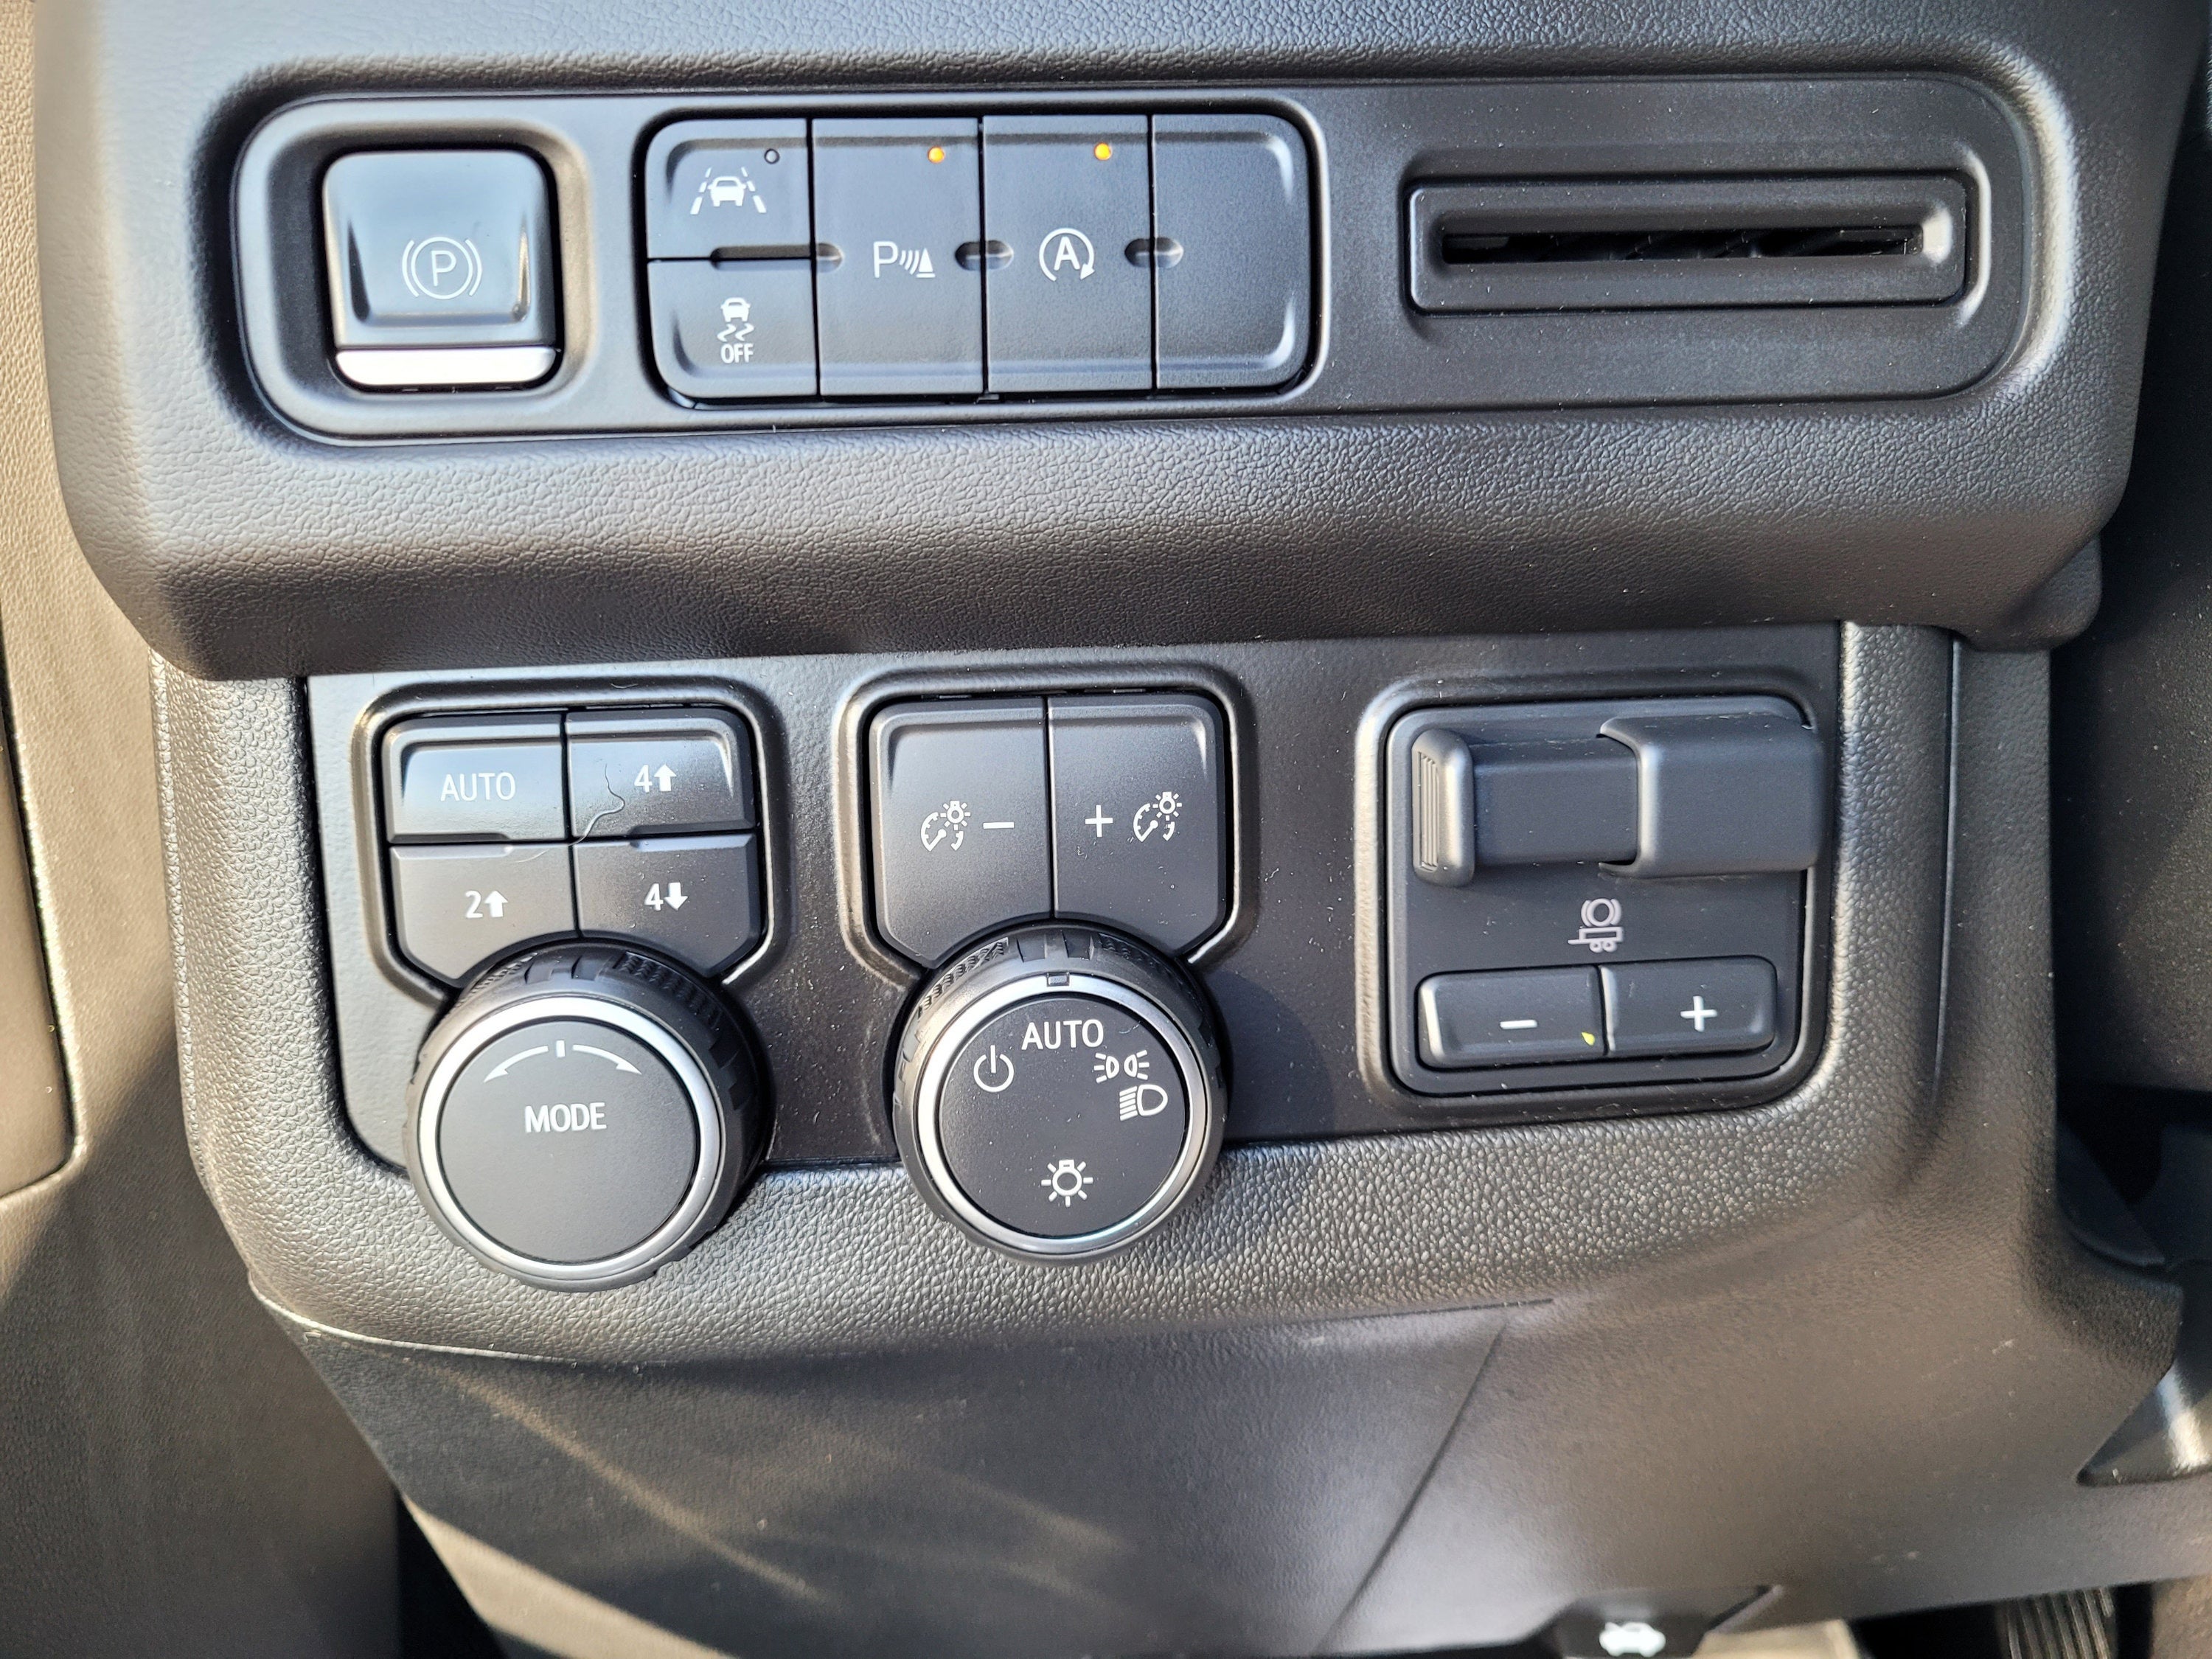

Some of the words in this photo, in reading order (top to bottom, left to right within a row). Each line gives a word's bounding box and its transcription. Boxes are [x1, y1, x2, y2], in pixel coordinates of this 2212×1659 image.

[873, 241, 897, 279] P
[720, 342, 754, 364] OFF
[439, 772, 516, 801] AUTO
[1021, 1018, 1105, 1051] AUTO
[524, 1102, 607, 1133] MODE
